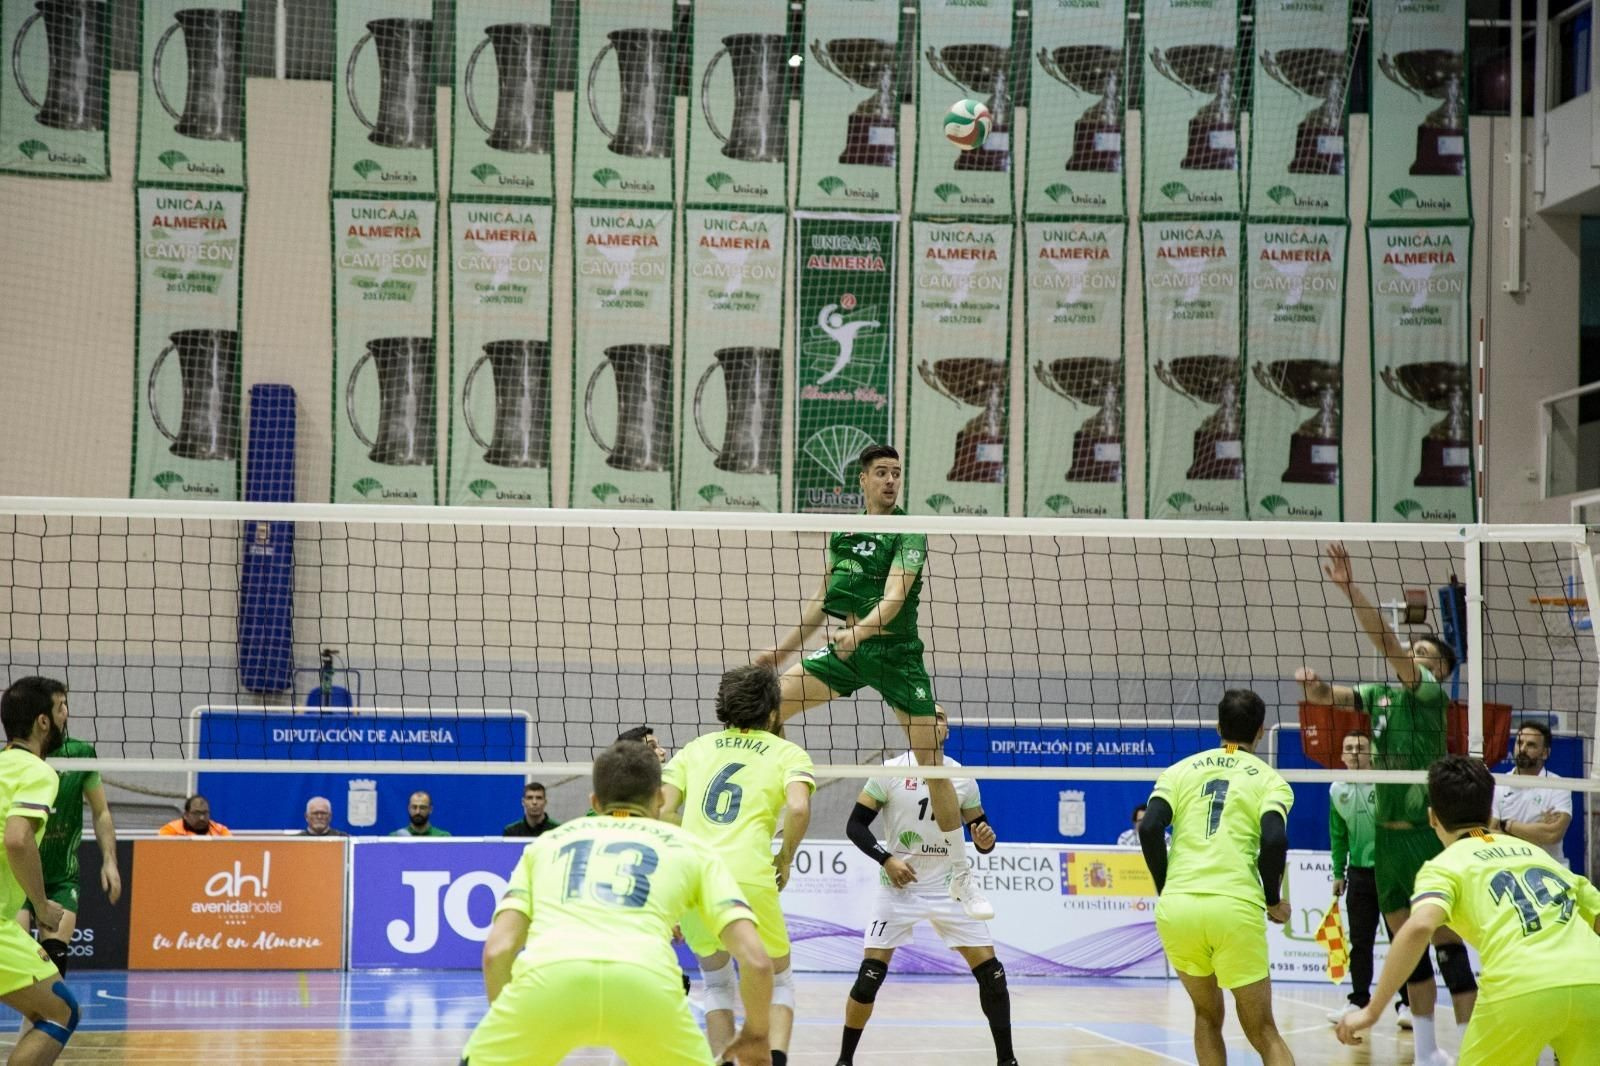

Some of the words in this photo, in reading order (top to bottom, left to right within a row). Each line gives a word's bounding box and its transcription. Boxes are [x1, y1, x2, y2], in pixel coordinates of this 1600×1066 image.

[48, 152, 87, 165] Unicaja
[187, 162, 226, 175] Unicaja
[380, 171, 418, 184] Unicaja
[498, 176, 535, 188] Unicaja
[620, 180, 656, 193] Unicaja
[732, 184, 769, 196] Unicaja
[844, 188, 880, 200] Unicaja
[960, 193, 996, 206] Unicaja
[1071, 193, 1107, 206] Unicaja
[1187, 192, 1223, 203] Unicaja
[155, 197, 224, 212] UNICAJA
[1293, 197, 1330, 209] Unicaja
[1415, 198, 1452, 210] Unicaja
[351, 207, 418, 221] UNICAJA
[467, 210, 535, 225] UNICAJA
[151, 214, 228, 231] ALMERÍA
[589, 216, 655, 229] UNICAJA
[703, 218, 769, 233] UNICAJA
[347, 223, 422, 239] ALMERÍA
[464, 226, 538, 242] ALMERÍA
[929, 230, 995, 244] UNICAJA
[1042, 229, 1108, 243] UNICAJA
[1159, 228, 1224, 242] UNICAJA
[1264, 231, 1329, 245] UNICAJA
[586, 231, 659, 247] ALMERÍA
[699, 234, 771, 250] ALMERÍA
[811, 234, 881, 252] UNICAJA
[1386, 234, 1452, 248] UNICAJA
[925, 245, 998, 262] ALMERÍA
[1039, 244, 1111, 260] ALMERÍA
[1156, 243, 1227, 259] ALMERÍA
[1259, 247, 1332, 263] ALMERÍA
[1383, 248, 1456, 264] ALMERÍA
[807, 255, 886, 272] ALMERÍA
[182, 483, 220, 496] Unicaja
[380, 488, 418, 500] Unicaja
[495, 489, 532, 502] Unicaja
[618, 494, 655, 506] Unicaja
[724, 495, 761, 508] Unicaja
[808, 487, 865, 508] Unicaj
[952, 504, 989, 516] Unicaja
[1072, 504, 1108, 516] Unicaja
[1193, 501, 1230, 514] Unicaja
[1287, 505, 1323, 518] Unicaja
[1421, 509, 1457, 521] Unicaja
[273, 728, 364, 743] DIPUTACIÓN
[367, 729, 387, 743] DE
[390, 728, 454, 744] ALMERÍA
[715, 738, 771, 756] BERNAL
[992, 739, 1071, 755] DIPUTACIÓN
[1073, 741, 1092, 755] DE
[1094, 740, 1155, 755] ALMERÍA
[701, 763, 745, 825] 6
[1201, 778, 1230, 840] 1
[921, 843, 949, 856] Unicaj
[1473, 847, 1533, 862] GRILLO
[795, 850, 847, 875] 016
[966, 856, 1054, 872] OLENCIA
[204, 850, 271, 898] ah!
[553, 839, 659, 908] 13
[1489, 867, 1576, 937] 19
[386, 871, 508, 955] JO
[870, 919, 887, 937] 11
[152, 933, 173, 950] tu
[176, 931, 223, 950] hotel
[226, 936, 249, 950] en
[66, 945, 94, 956] DOS
